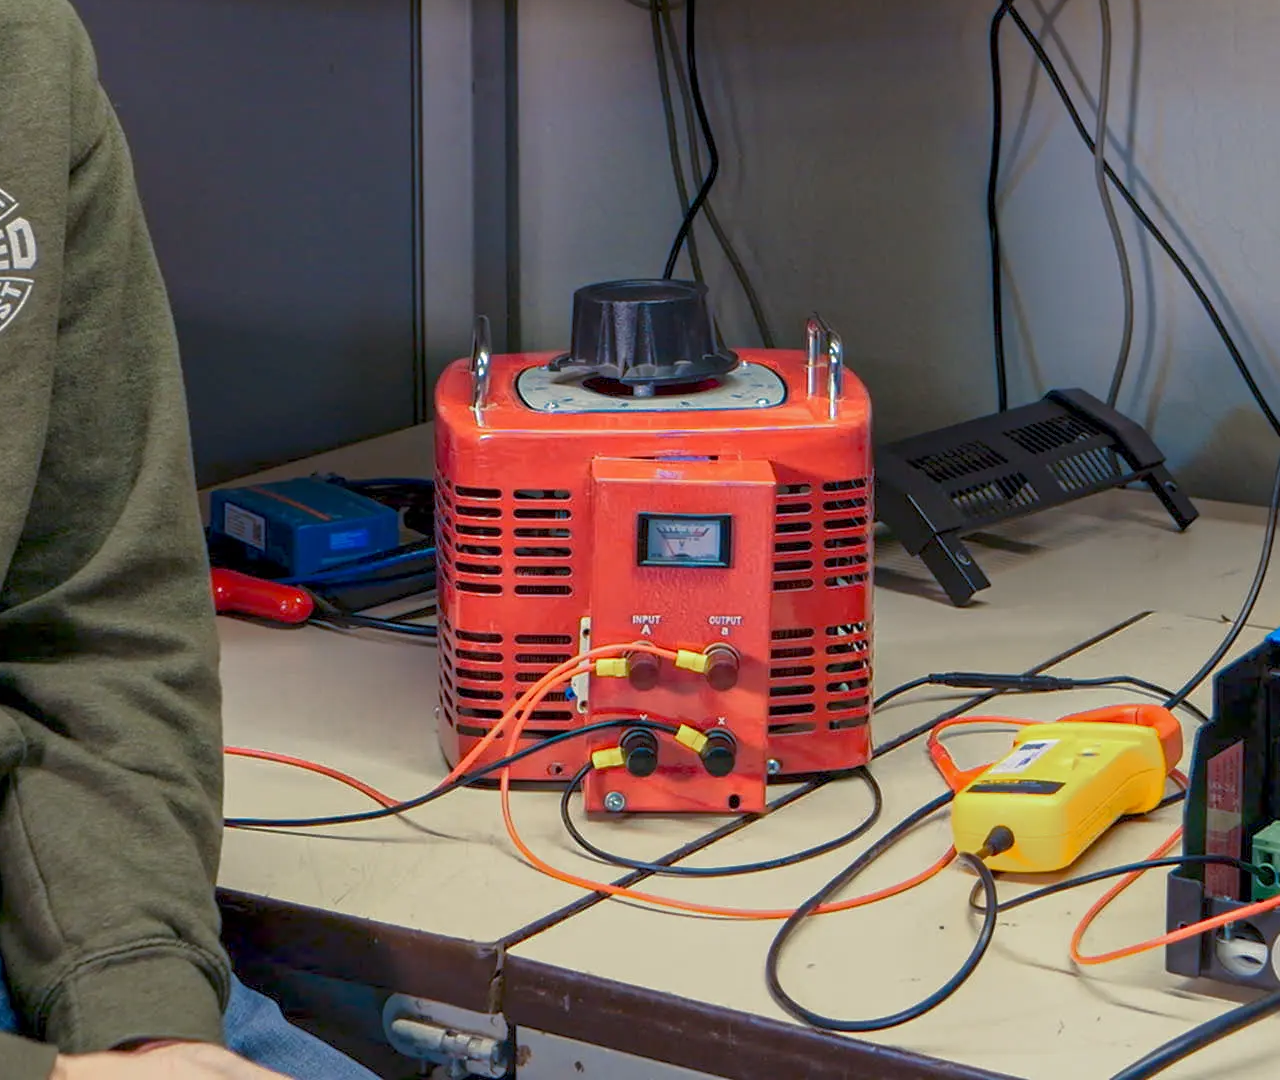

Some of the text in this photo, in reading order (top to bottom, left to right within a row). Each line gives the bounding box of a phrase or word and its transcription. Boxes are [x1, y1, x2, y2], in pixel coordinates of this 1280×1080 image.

[632, 615, 661, 624] INPUT
[709, 616, 742, 625] OUTPUT
[641, 624, 651, 635] A
